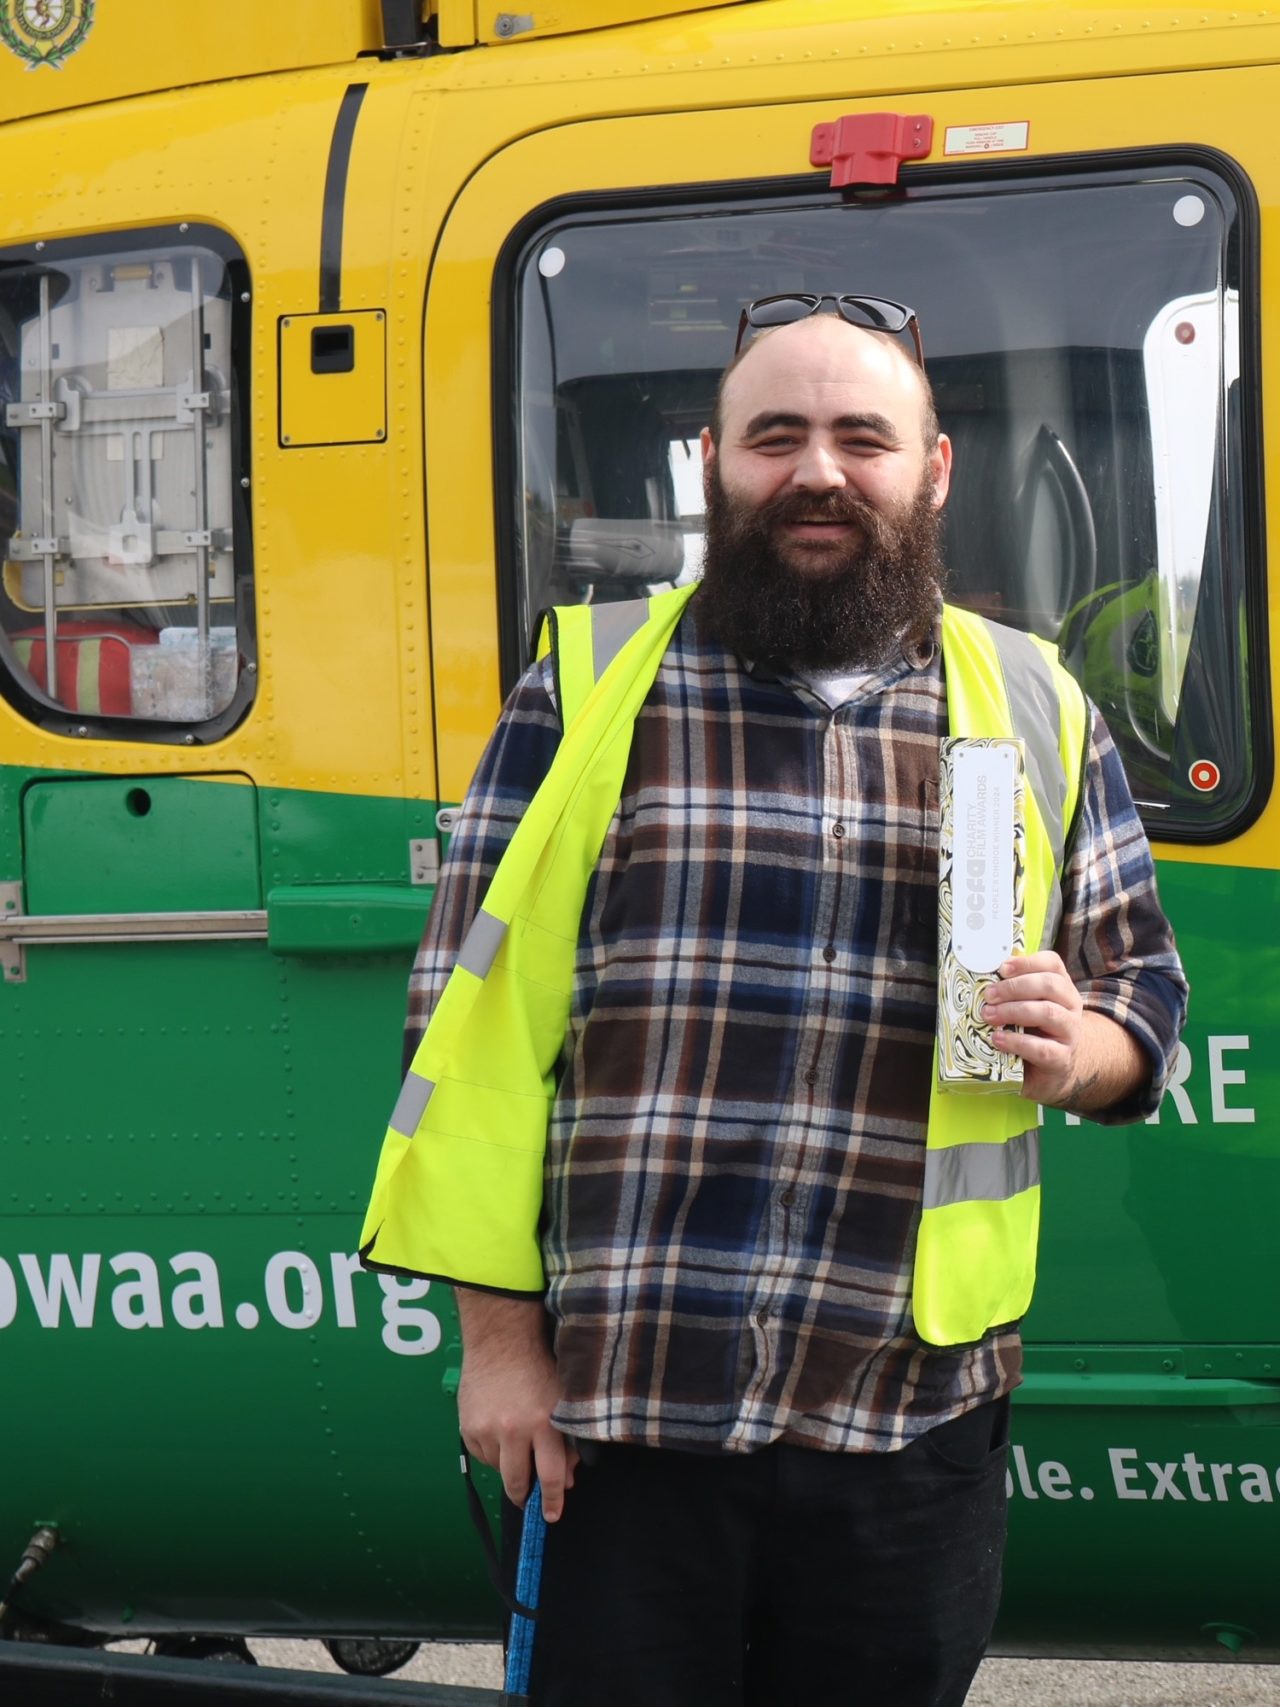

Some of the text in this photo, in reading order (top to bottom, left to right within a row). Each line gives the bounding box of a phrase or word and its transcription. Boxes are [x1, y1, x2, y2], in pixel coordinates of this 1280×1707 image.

[966, 802, 977, 859] CHARITY
[976, 775, 987, 858] FILM AWARDS
[1005, 1445, 1095, 1500] le.
